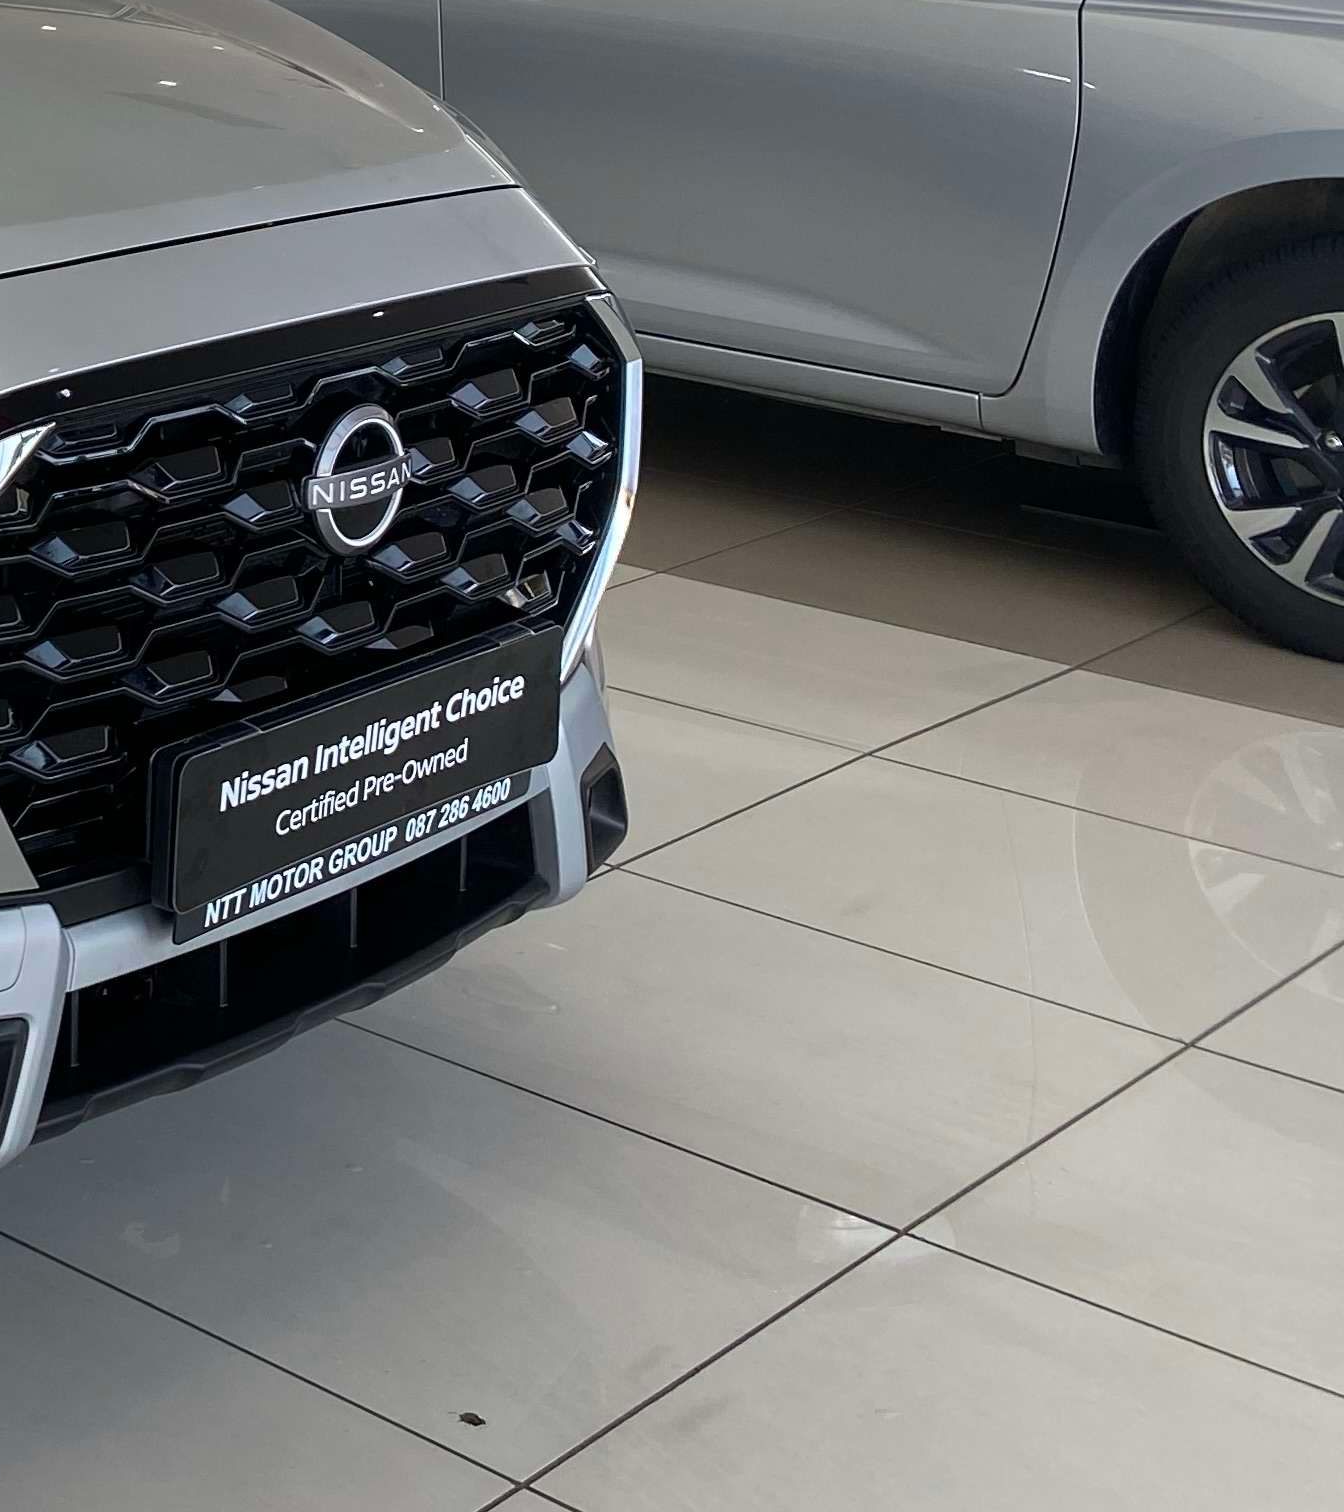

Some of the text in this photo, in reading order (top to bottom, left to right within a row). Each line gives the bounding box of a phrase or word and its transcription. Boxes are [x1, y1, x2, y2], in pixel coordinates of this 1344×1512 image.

[312, 459, 412, 506] NISSAN
[219, 675, 526, 812] Nissan Intelligent Choice
[275, 737, 469, 835] Certified Pre-Owned
[204, 777, 512, 928] NTT MOTOR GROUP 087 286 4600
